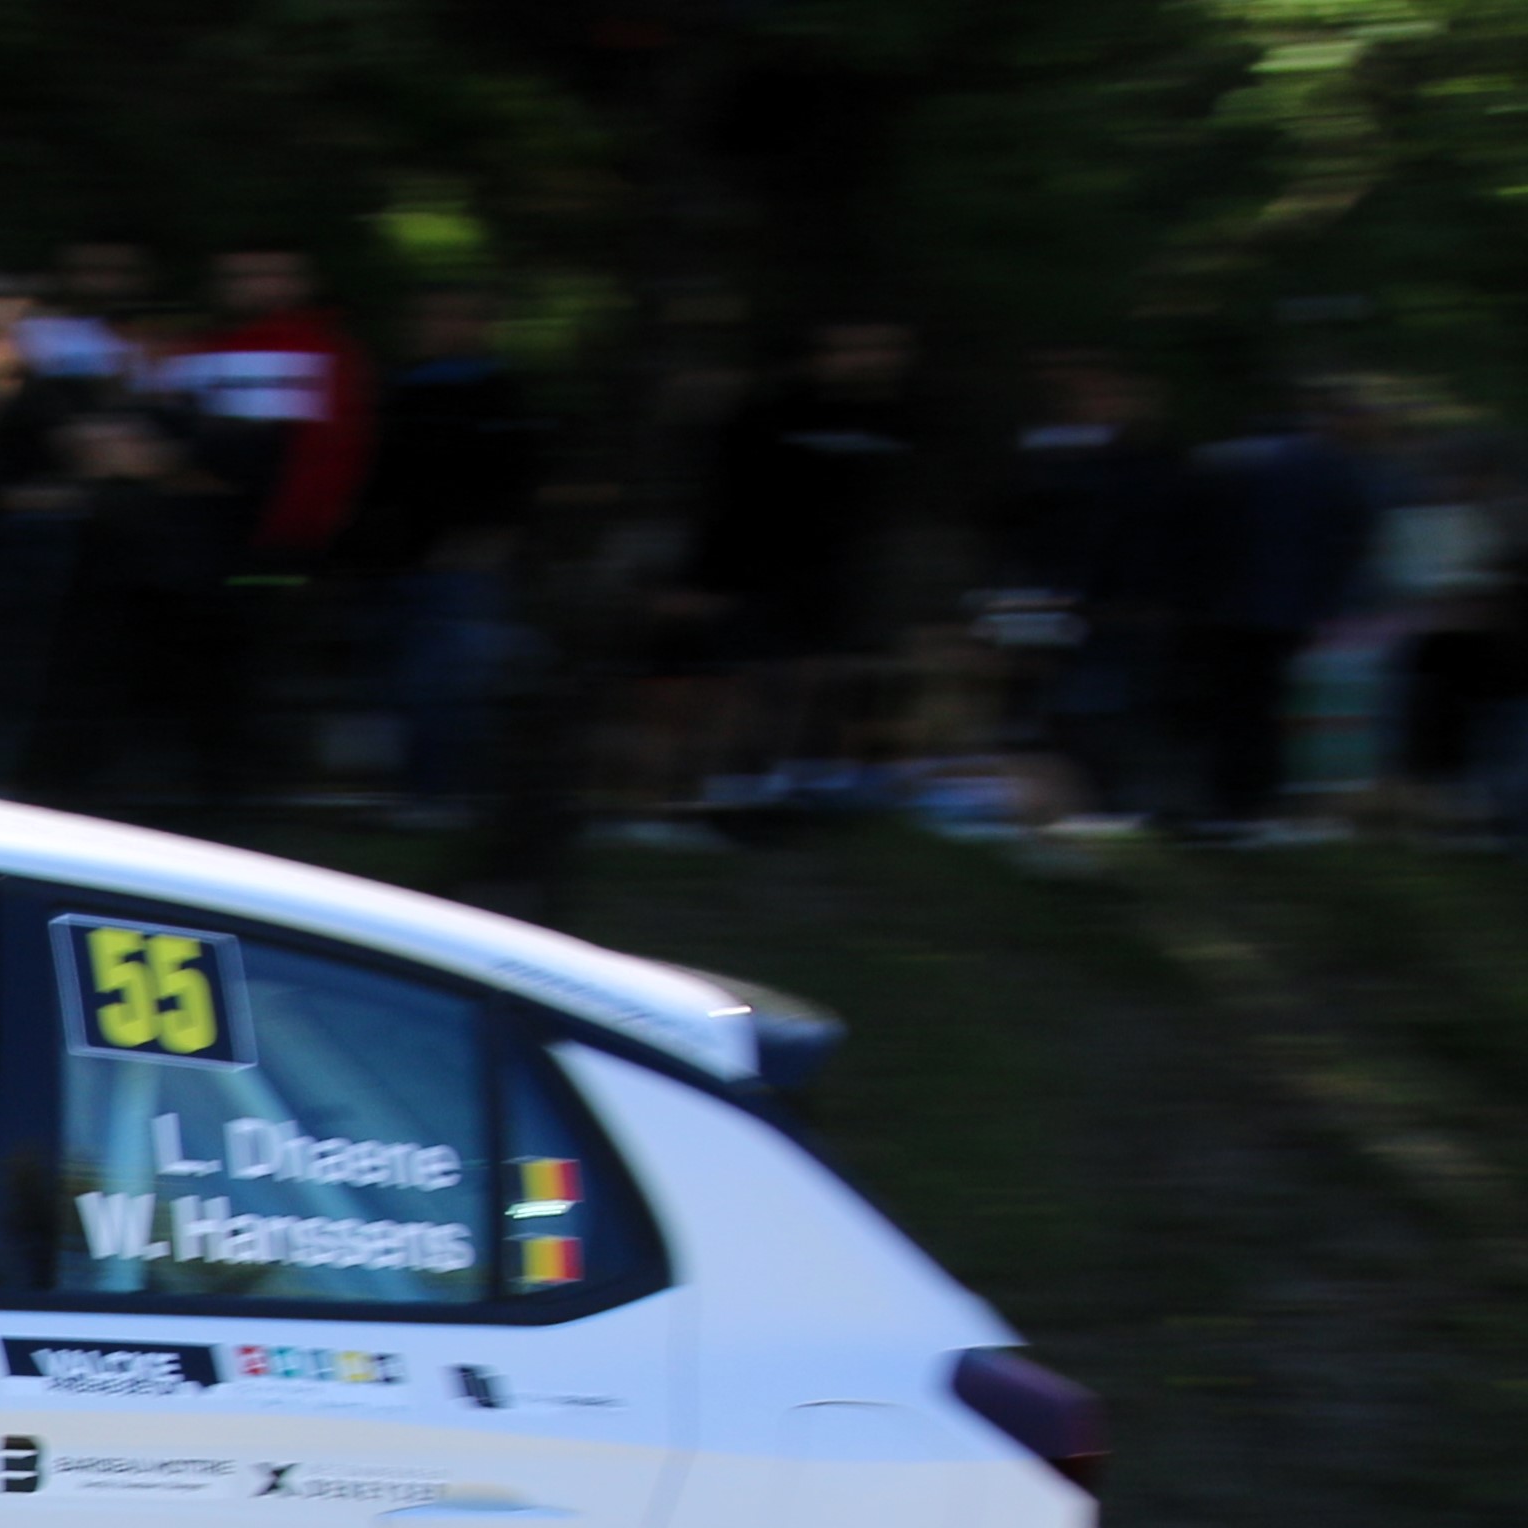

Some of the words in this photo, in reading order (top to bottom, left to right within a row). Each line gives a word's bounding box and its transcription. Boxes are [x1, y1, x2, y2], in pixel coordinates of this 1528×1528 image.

[86, 927, 217, 1054] 55
[152, 1112, 221, 1177] L.
[76, 1191, 171, 1260] W.
